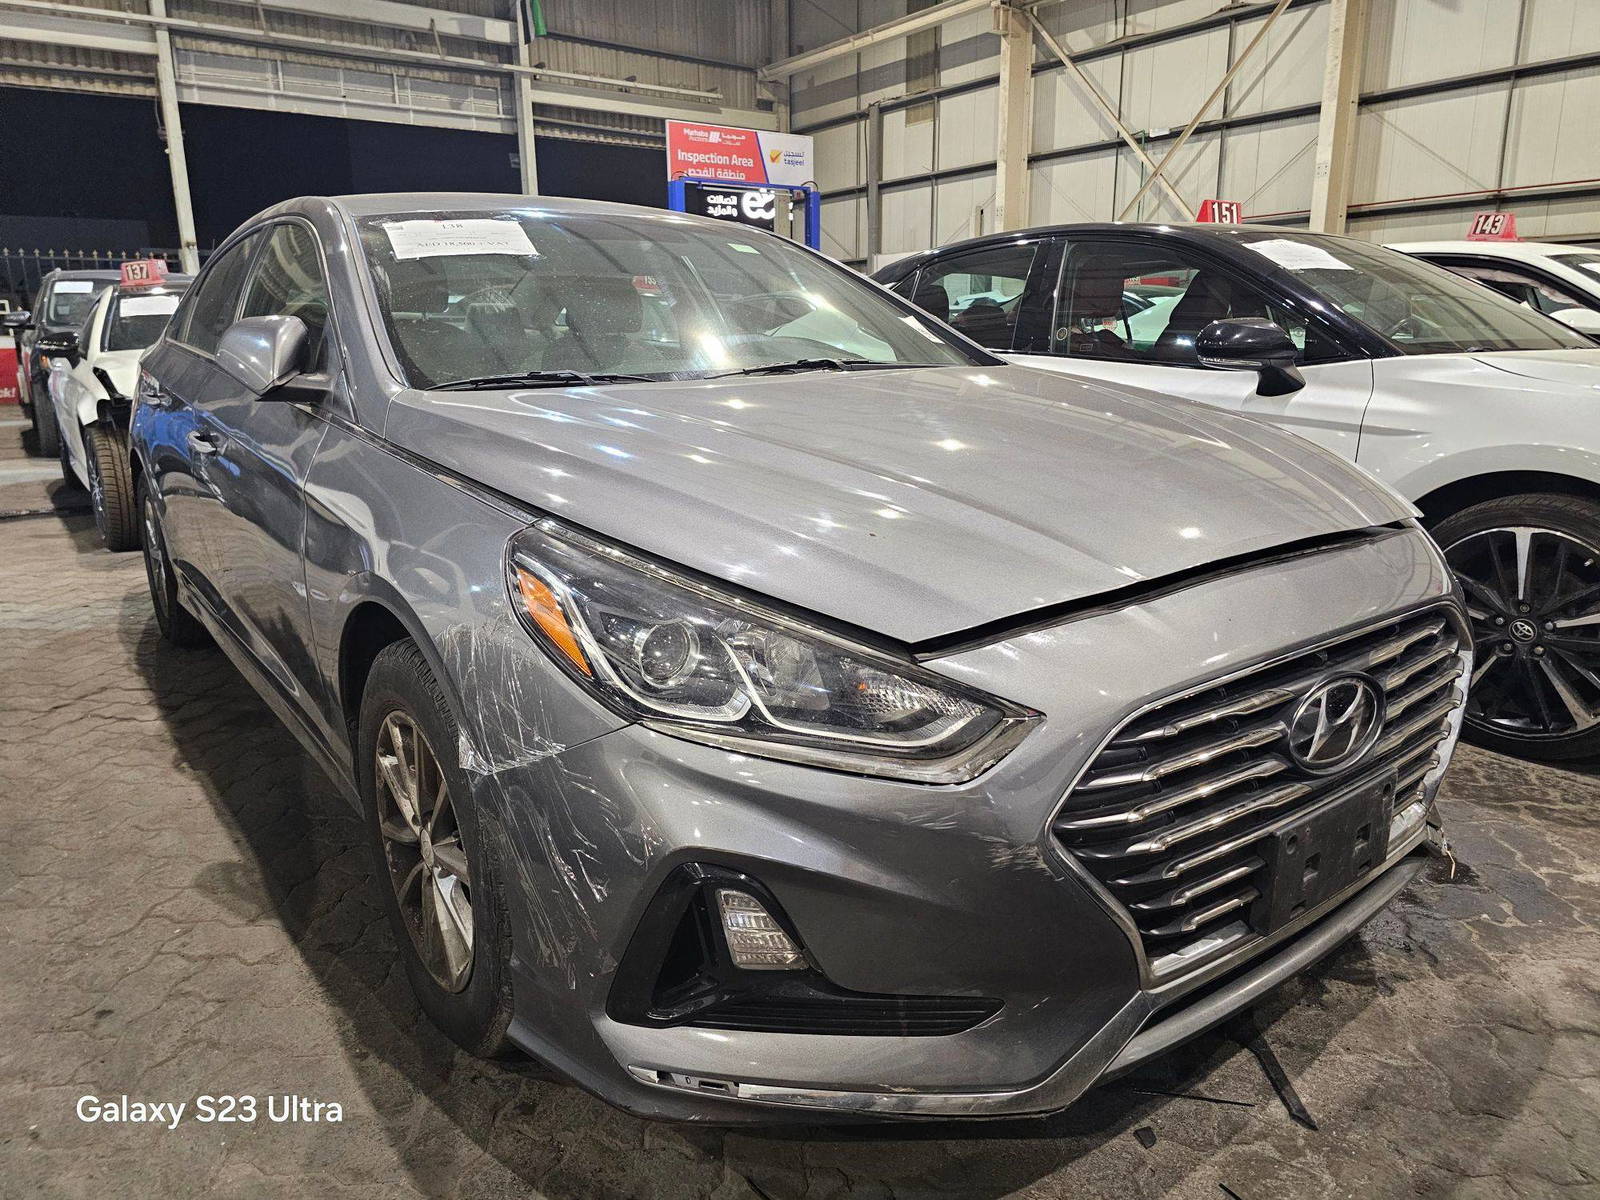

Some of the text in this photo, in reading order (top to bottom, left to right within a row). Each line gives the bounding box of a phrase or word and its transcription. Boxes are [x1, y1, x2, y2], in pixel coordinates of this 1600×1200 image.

[677, 149, 754, 167] Inspection Area
[1212, 202, 1238, 224] 151
[1475, 214, 1505, 235] 143
[126, 263, 148, 281] 137
